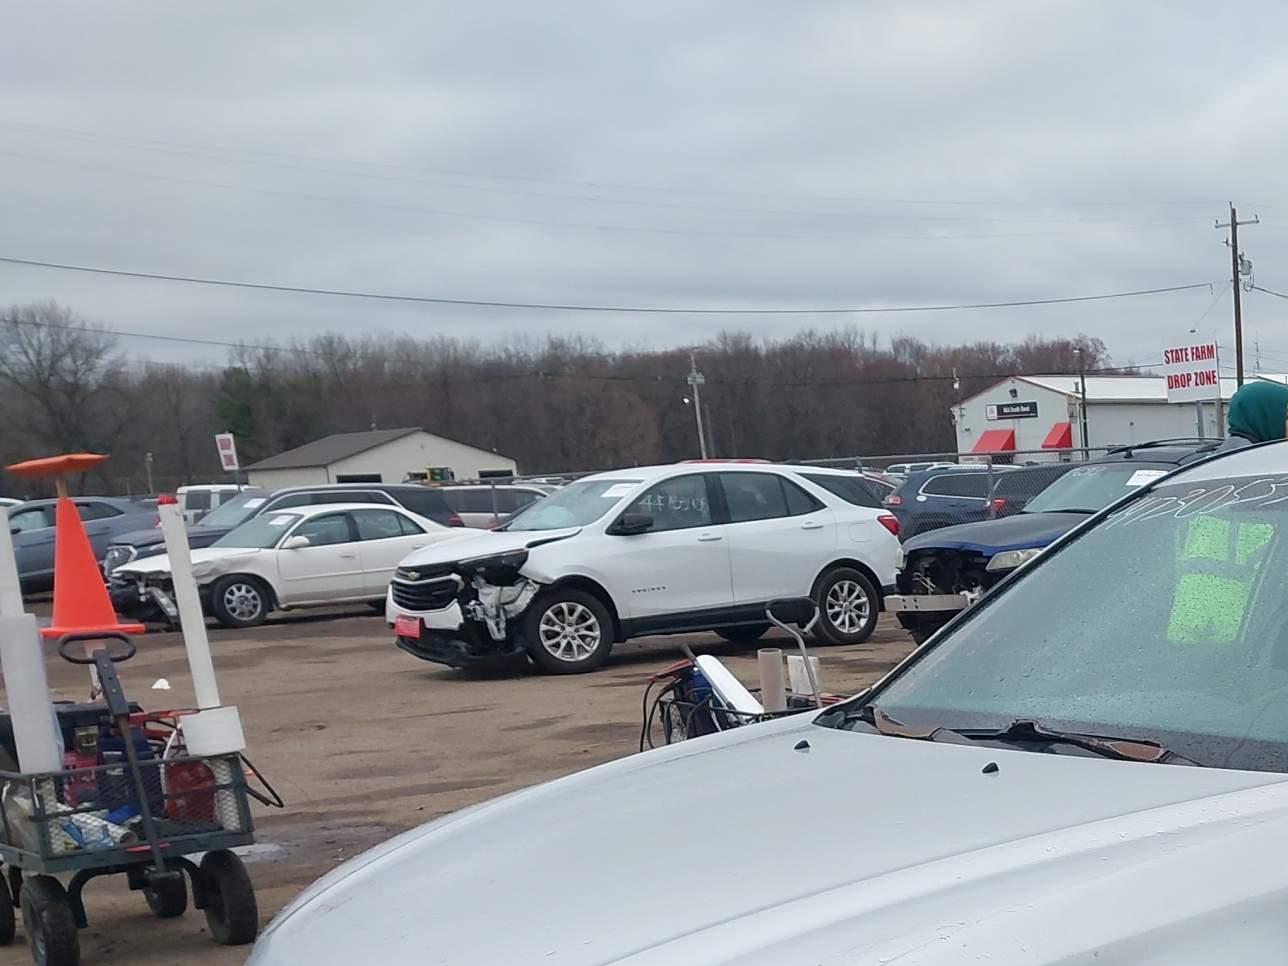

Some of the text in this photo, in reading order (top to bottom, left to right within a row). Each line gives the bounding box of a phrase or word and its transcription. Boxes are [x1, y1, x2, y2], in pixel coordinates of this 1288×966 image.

[1164, 344, 1215, 365] STATE FARM
[1167, 370, 1218, 390] DROP ZONE
